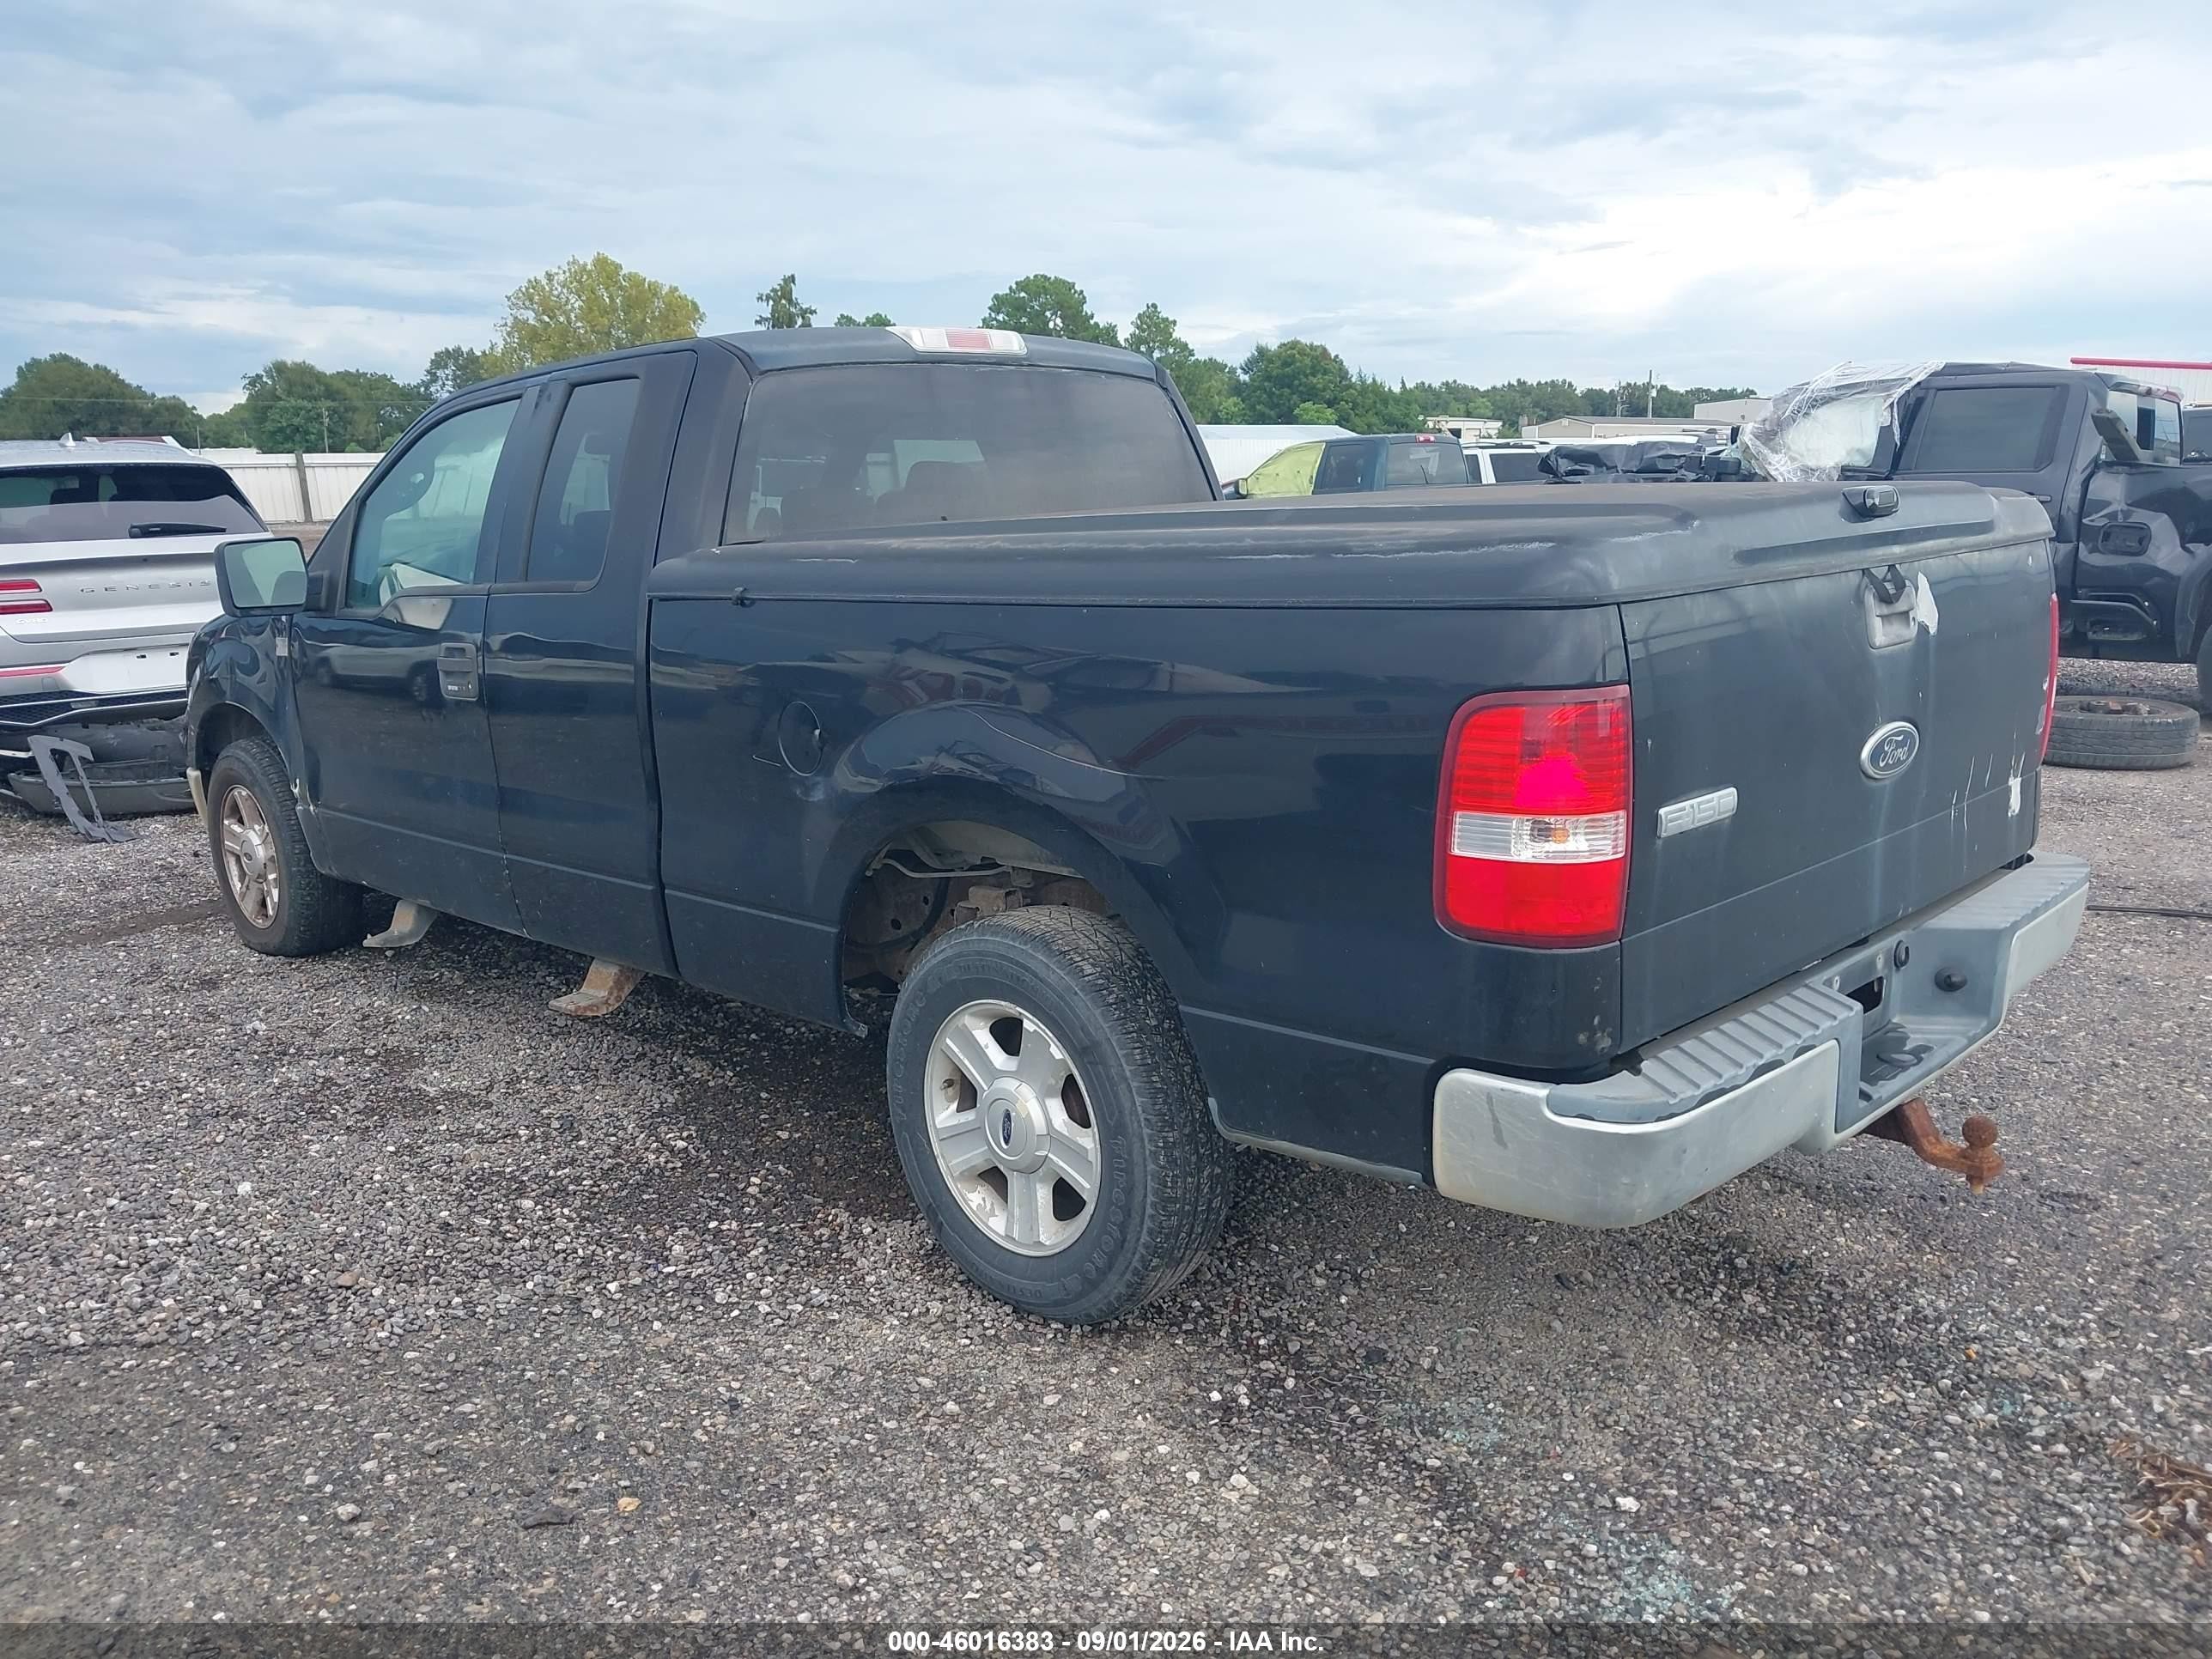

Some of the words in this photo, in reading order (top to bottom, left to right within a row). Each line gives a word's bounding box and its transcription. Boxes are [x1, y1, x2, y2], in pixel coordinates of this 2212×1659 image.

[80, 580, 211, 593] GENESIS
[1879, 734, 1911, 767] Ford
[1662, 788, 1735, 836] F-150
